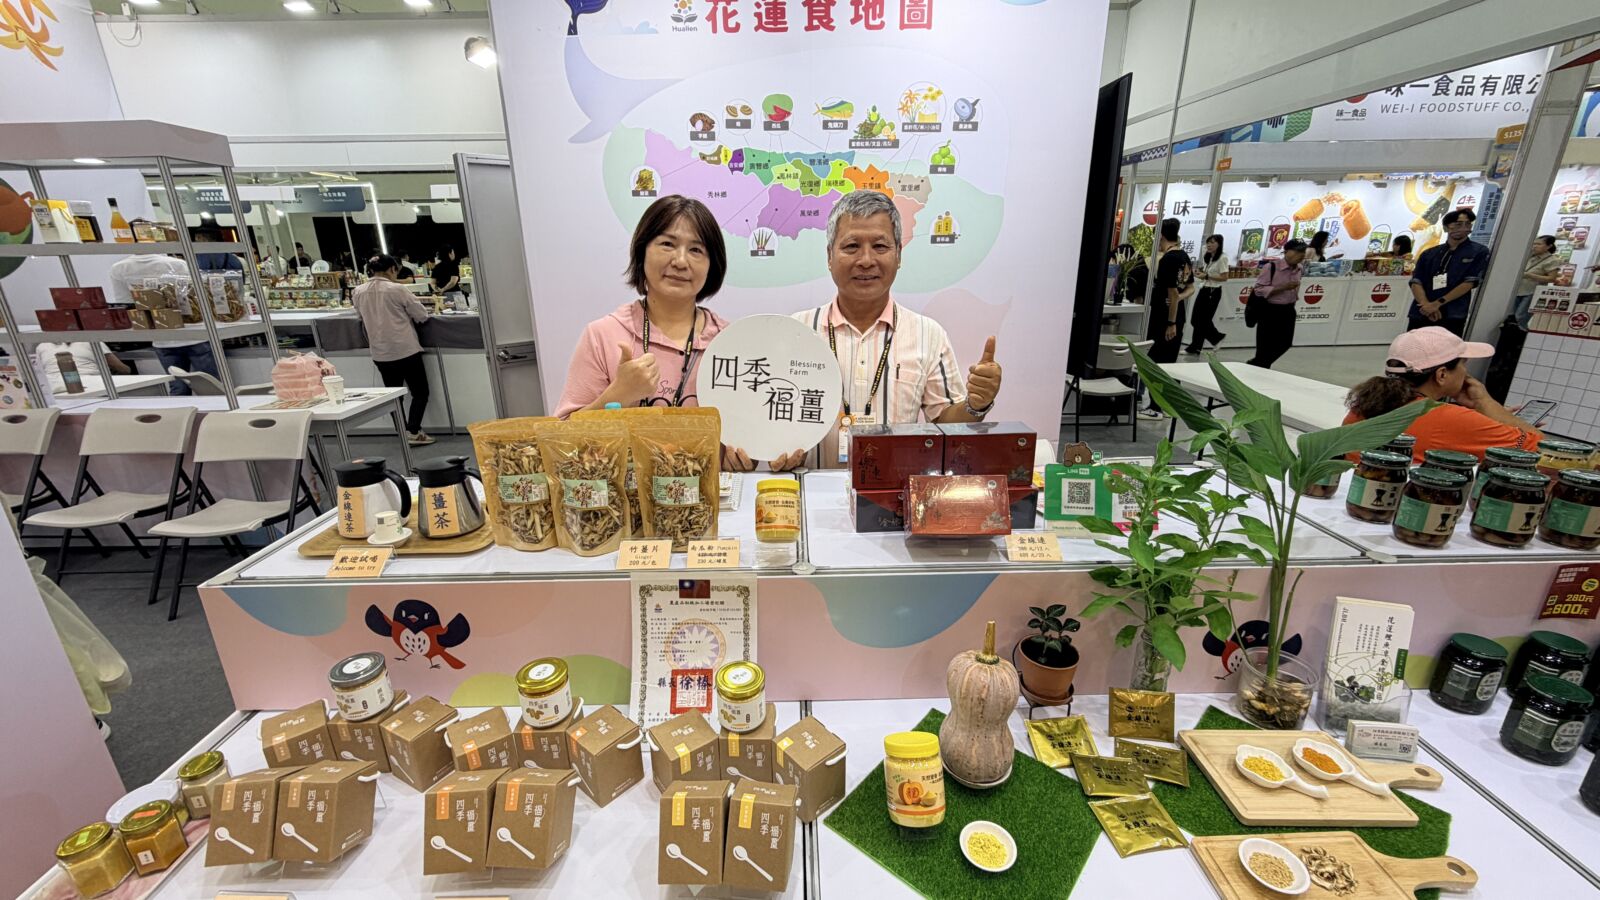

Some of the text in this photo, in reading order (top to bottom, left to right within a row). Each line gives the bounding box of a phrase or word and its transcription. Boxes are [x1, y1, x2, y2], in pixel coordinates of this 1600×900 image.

[671, 25, 698, 33] Hualien
[1335, 108, 1367, 118] 味一食品
[1380, 103, 1414, 114] WEI-I
[1419, 102, 1500, 113] FOODSTUFF
[900, 184, 920, 192] 富里鄉
[790, 359, 826, 369] Blessings
[711, 354, 771, 393] 四季
[789, 368, 809, 376] Farm
[431, 492, 451, 530] 薑茶
[628, 544, 659, 553] 竹薑片
[338, 555, 379, 564] 歡迎試喝
[242, 790, 252, 813] 四季
[307, 789, 316, 811] 四季
[692, 807, 701, 830] 四季
[760, 812, 770, 836] 四季
